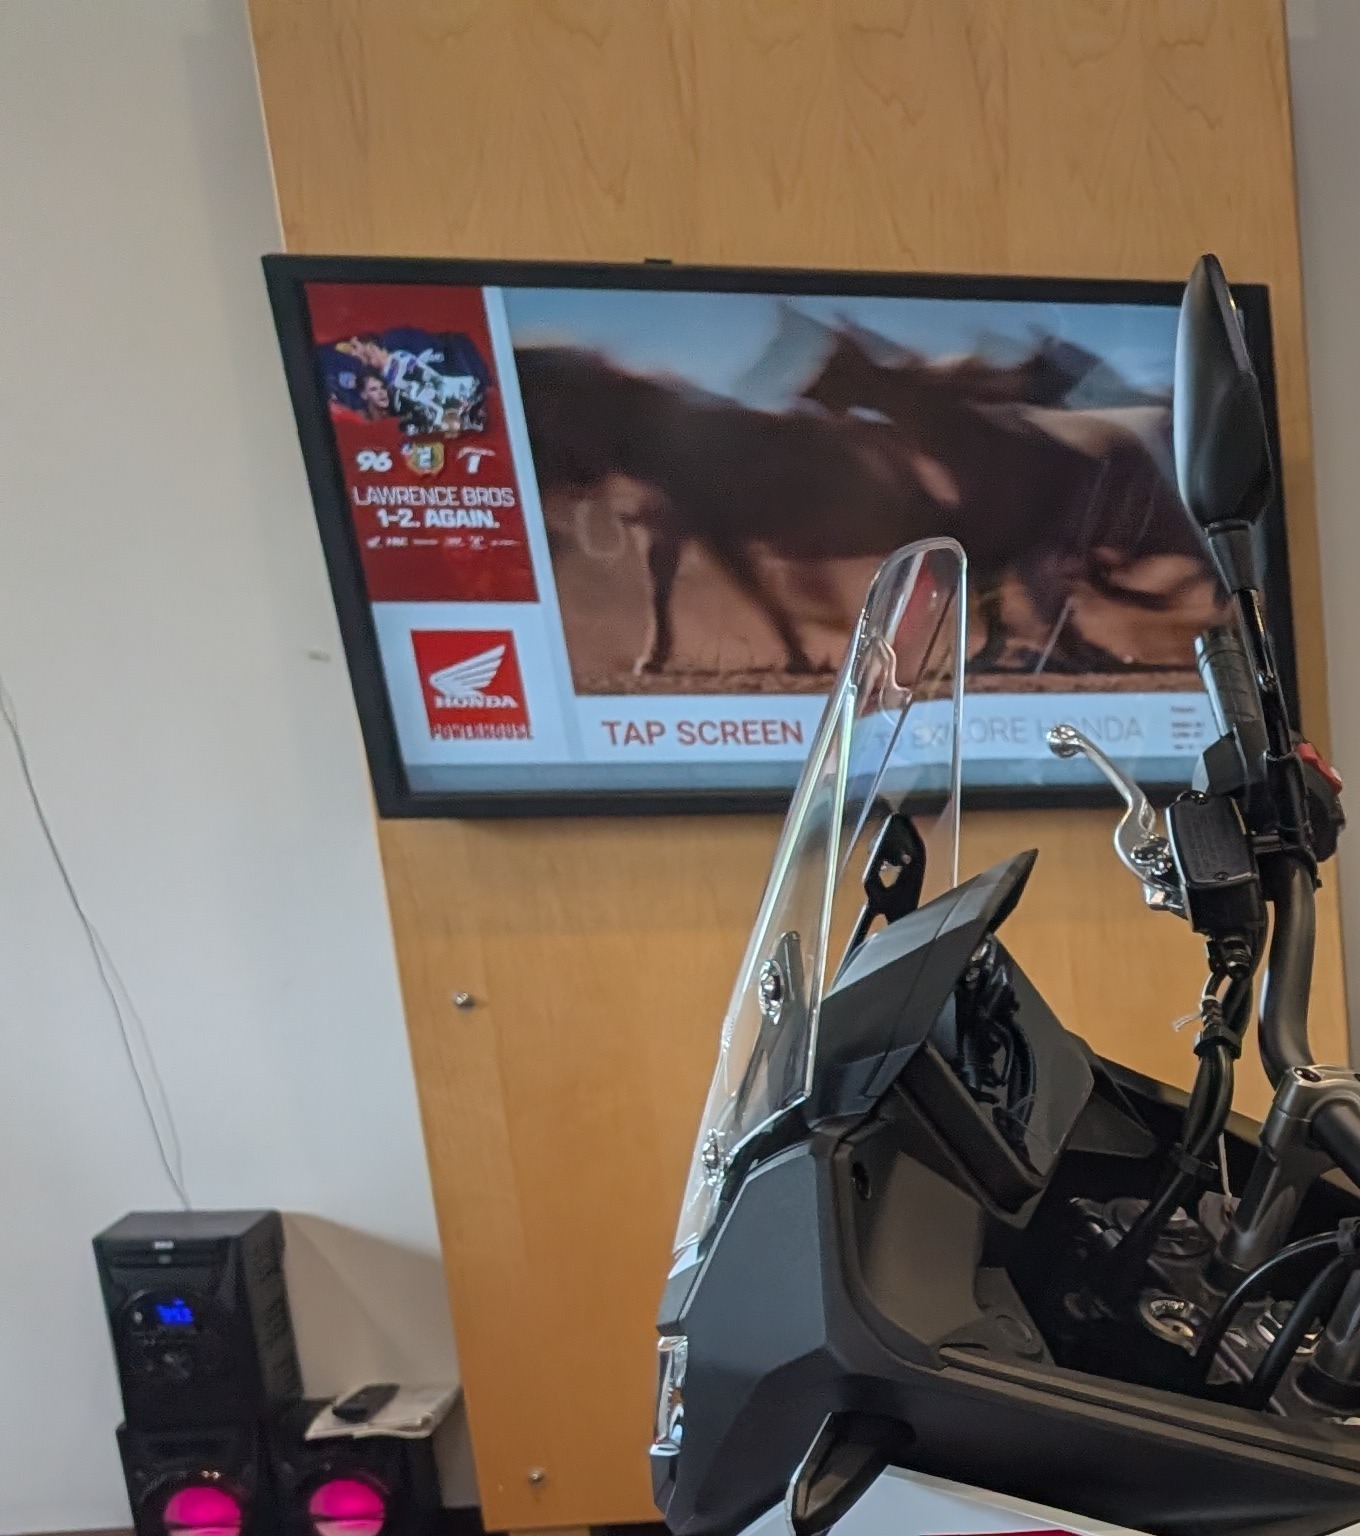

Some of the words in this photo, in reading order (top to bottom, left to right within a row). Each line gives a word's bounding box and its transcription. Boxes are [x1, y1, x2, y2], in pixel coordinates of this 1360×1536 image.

[352, 485, 460, 507] LAWRENCE
[462, 487, 516, 508] BROS
[434, 694, 519, 709] HONDA
[602, 719, 666, 747] TAP
[677, 719, 803, 746] SCREEN
